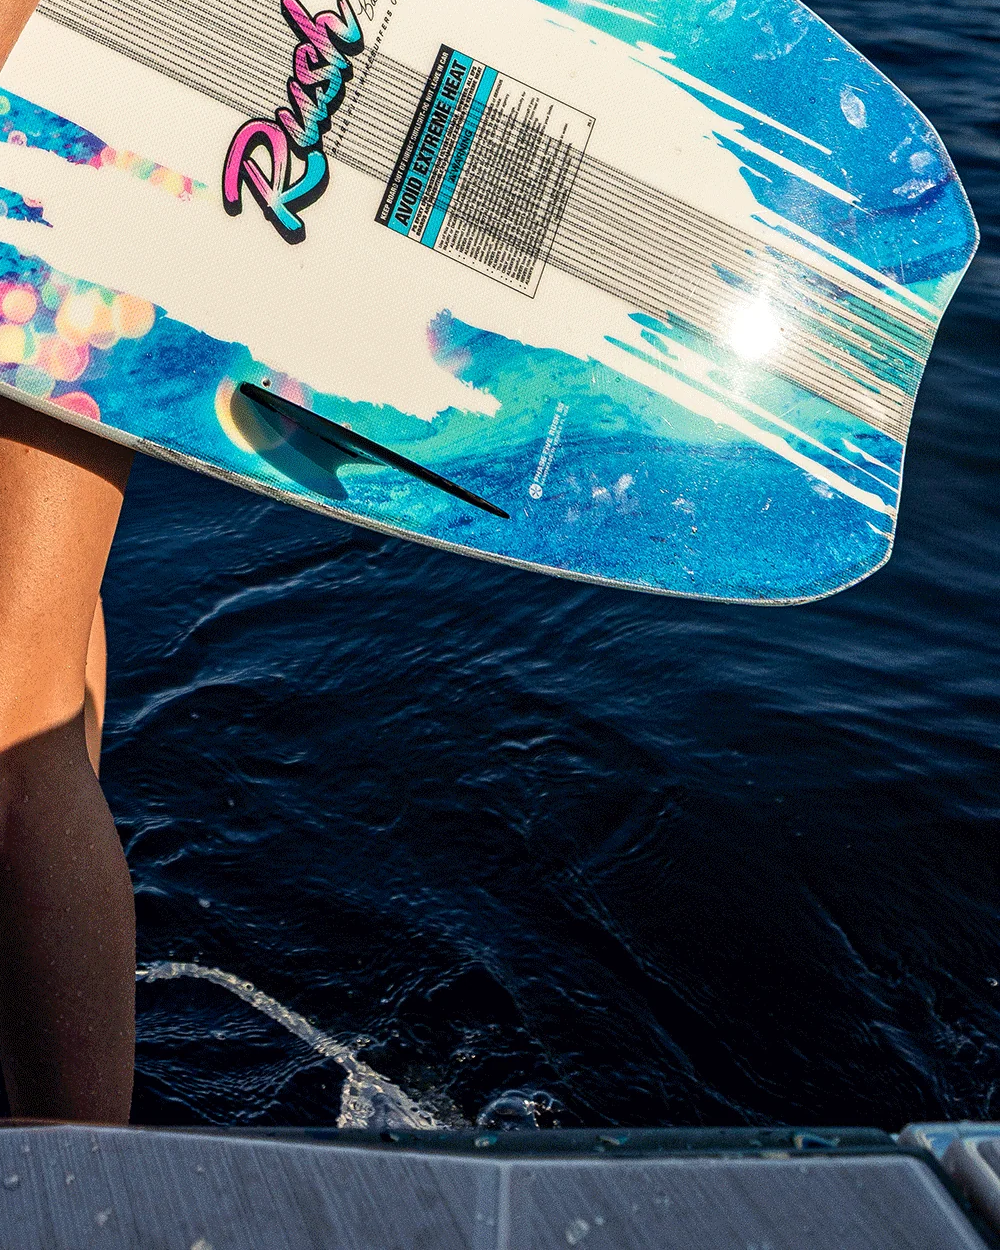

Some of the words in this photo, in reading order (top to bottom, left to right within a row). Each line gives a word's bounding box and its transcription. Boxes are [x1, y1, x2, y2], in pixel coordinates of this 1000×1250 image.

[439, 51, 448, 64] CAR
[436, 64, 444, 72] IN
[429, 71, 441, 89] LEAVE
[425, 89, 434, 102] NOT
[393, 175, 423, 226] AVOID
[412, 100, 451, 175] EXTREME
[440, 58, 467, 101] HEAT
[402, 140, 415, 162] DIRECT
[451, 129, 472, 173] WARNING
[394, 170, 403, 183] OUT
[386, 182, 398, 204] BOARD
[379, 203, 391, 220] KEEP
[533, 455, 546, 482] PHASE
[542, 436, 552, 454] FIVE
[548, 413, 560, 436] RUSH
